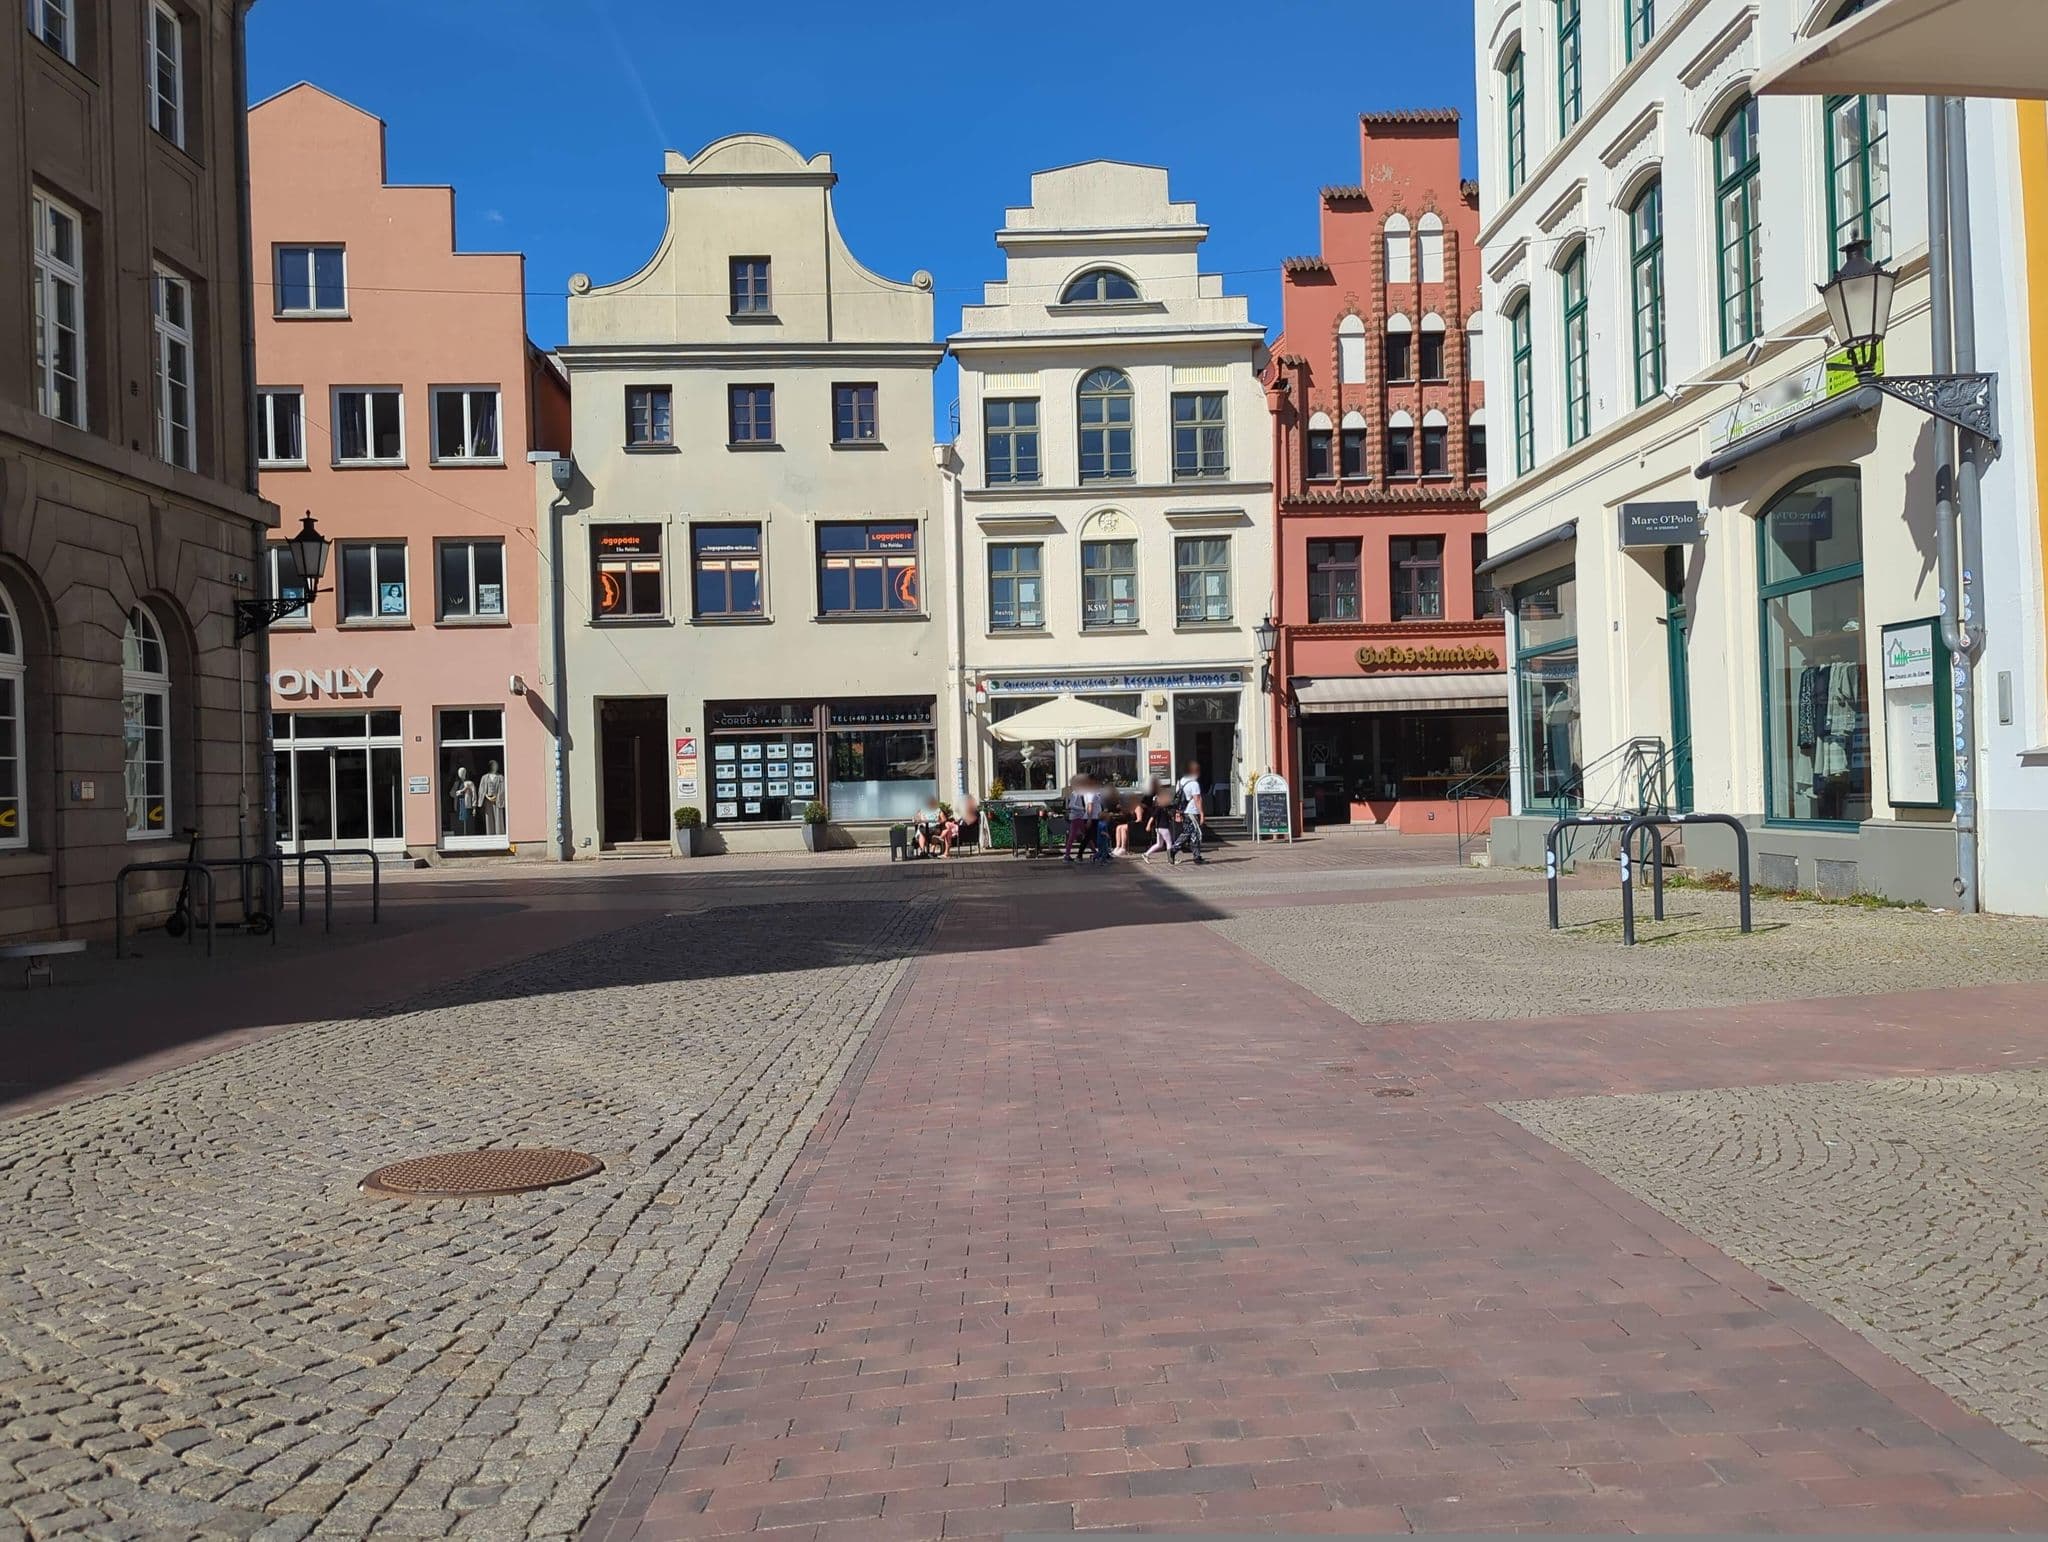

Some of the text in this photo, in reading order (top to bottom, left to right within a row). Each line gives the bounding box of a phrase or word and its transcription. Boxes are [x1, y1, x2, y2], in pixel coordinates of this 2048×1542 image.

[1631, 514, 1693, 525] Marc O'Polo
[1087, 603, 1107, 612] KSW
[1355, 644, 1495, 666] Goldschmiede
[273, 666, 379, 695] ONLY
[720, 717, 758, 725] CORDES
